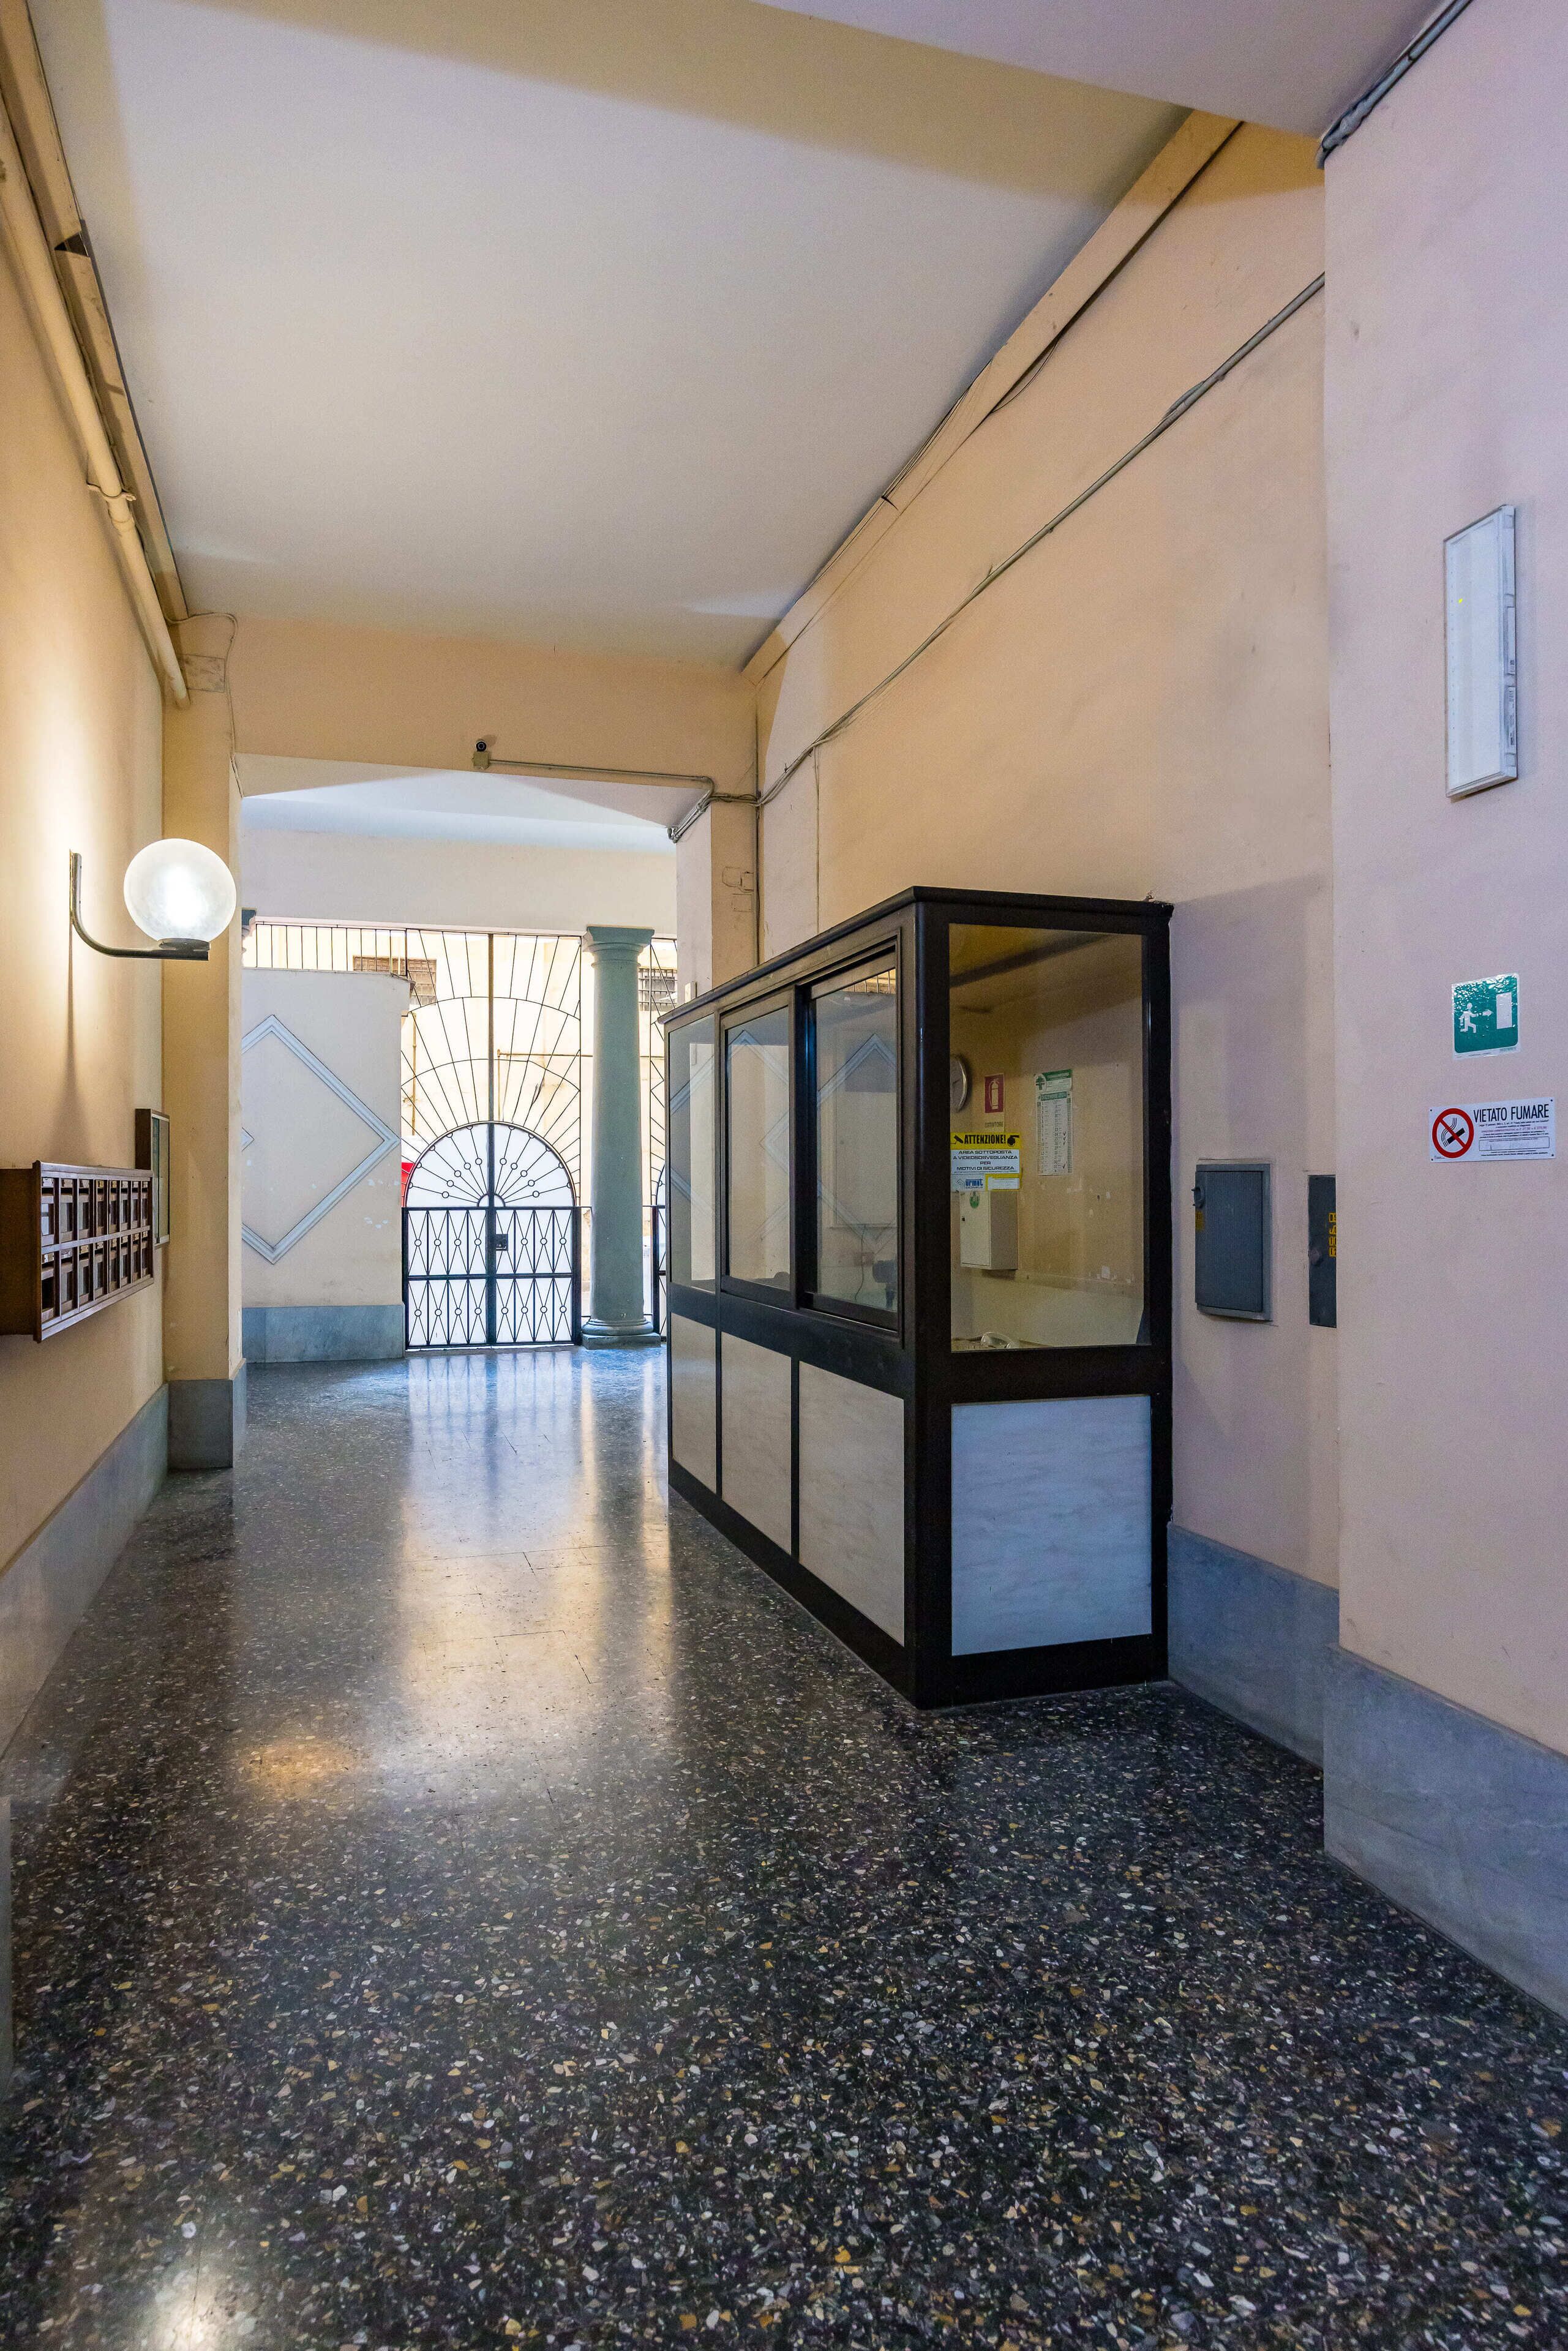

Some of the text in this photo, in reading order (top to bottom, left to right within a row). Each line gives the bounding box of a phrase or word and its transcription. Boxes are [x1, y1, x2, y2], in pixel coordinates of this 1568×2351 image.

[1473, 1104, 1550, 1123] VIETATO FUMARE
[964, 1134, 1007, 1144] ATTENZIONE!
